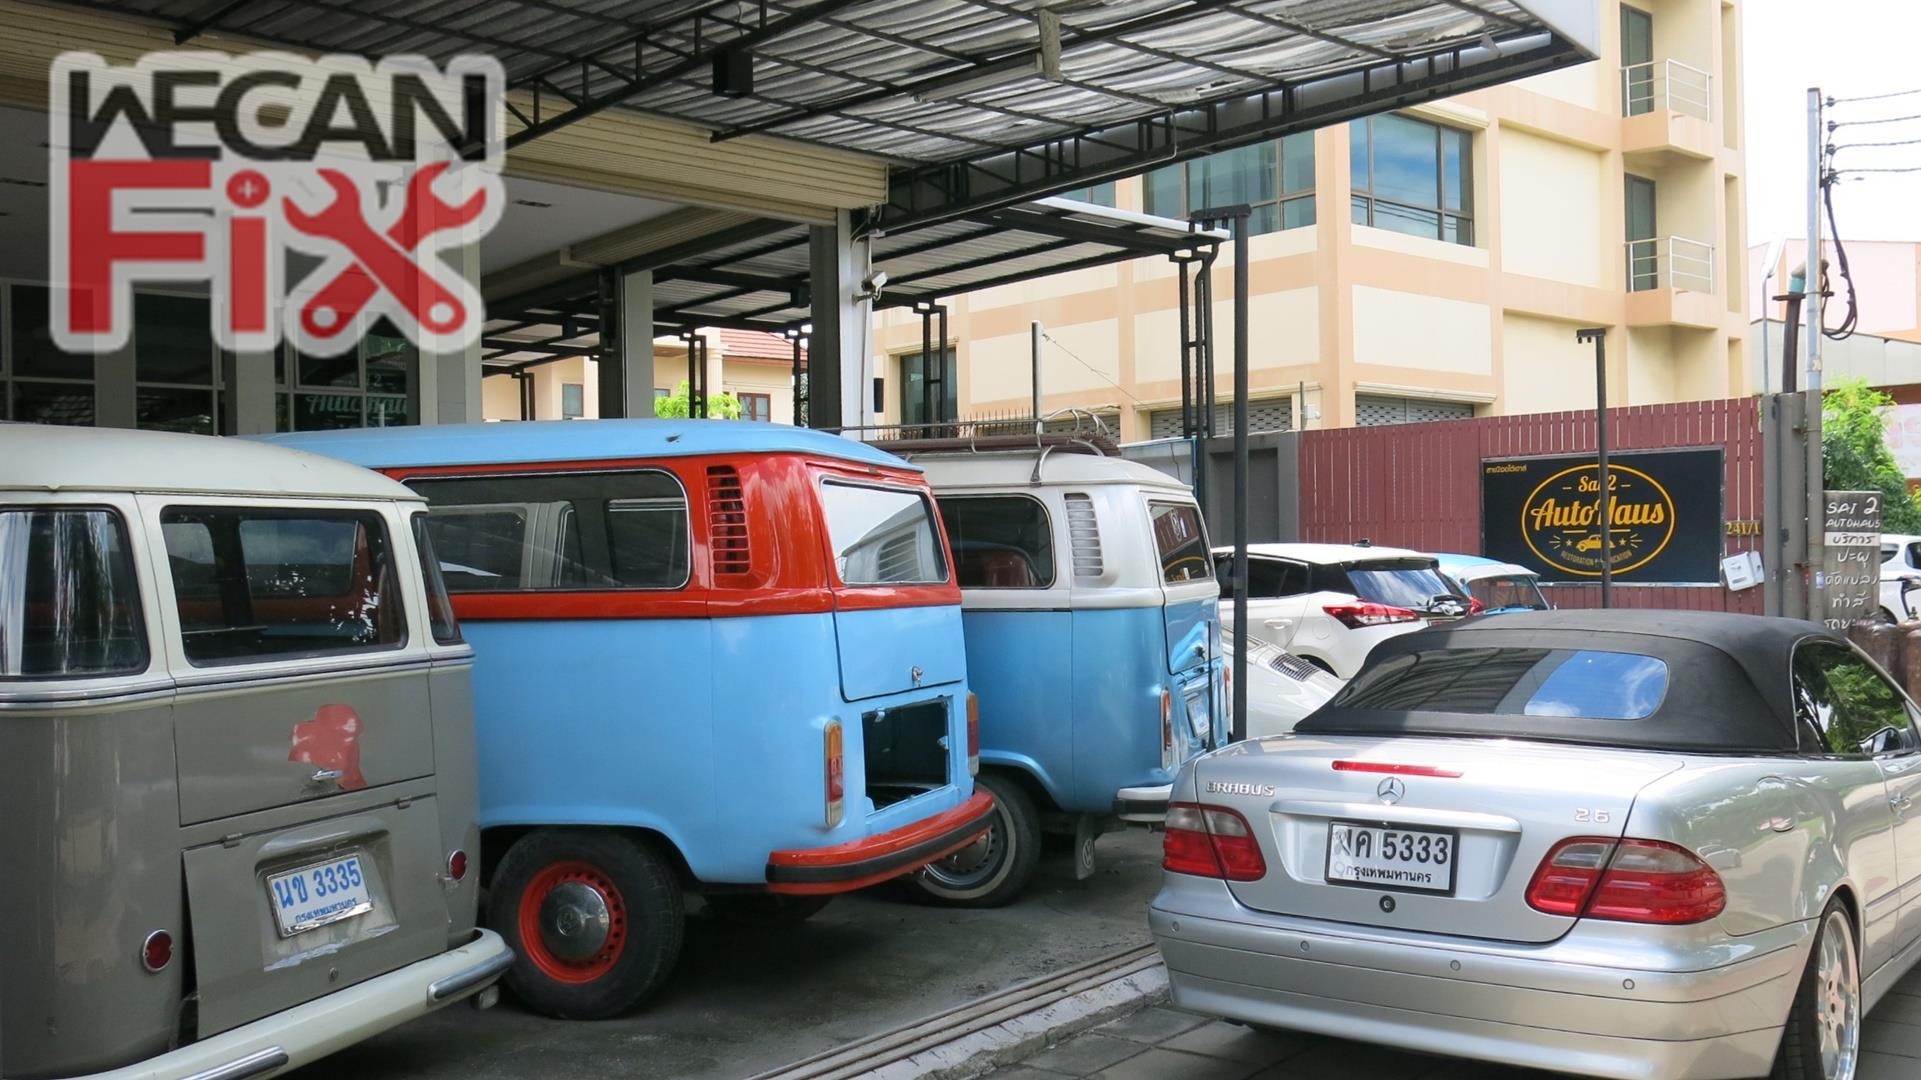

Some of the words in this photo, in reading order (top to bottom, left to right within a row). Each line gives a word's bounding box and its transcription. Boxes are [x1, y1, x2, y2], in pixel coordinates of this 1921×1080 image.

[1578, 476, 1601, 492] Sa
[1826, 502, 1858, 514] SAI
[1864, 497, 1880, 514] 2
[1826, 518, 1880, 528] AUTOHAUS
[1207, 781, 1275, 797] BRABUS
[1382, 832, 1448, 865] 5333
[313, 860, 361, 897] 3335
